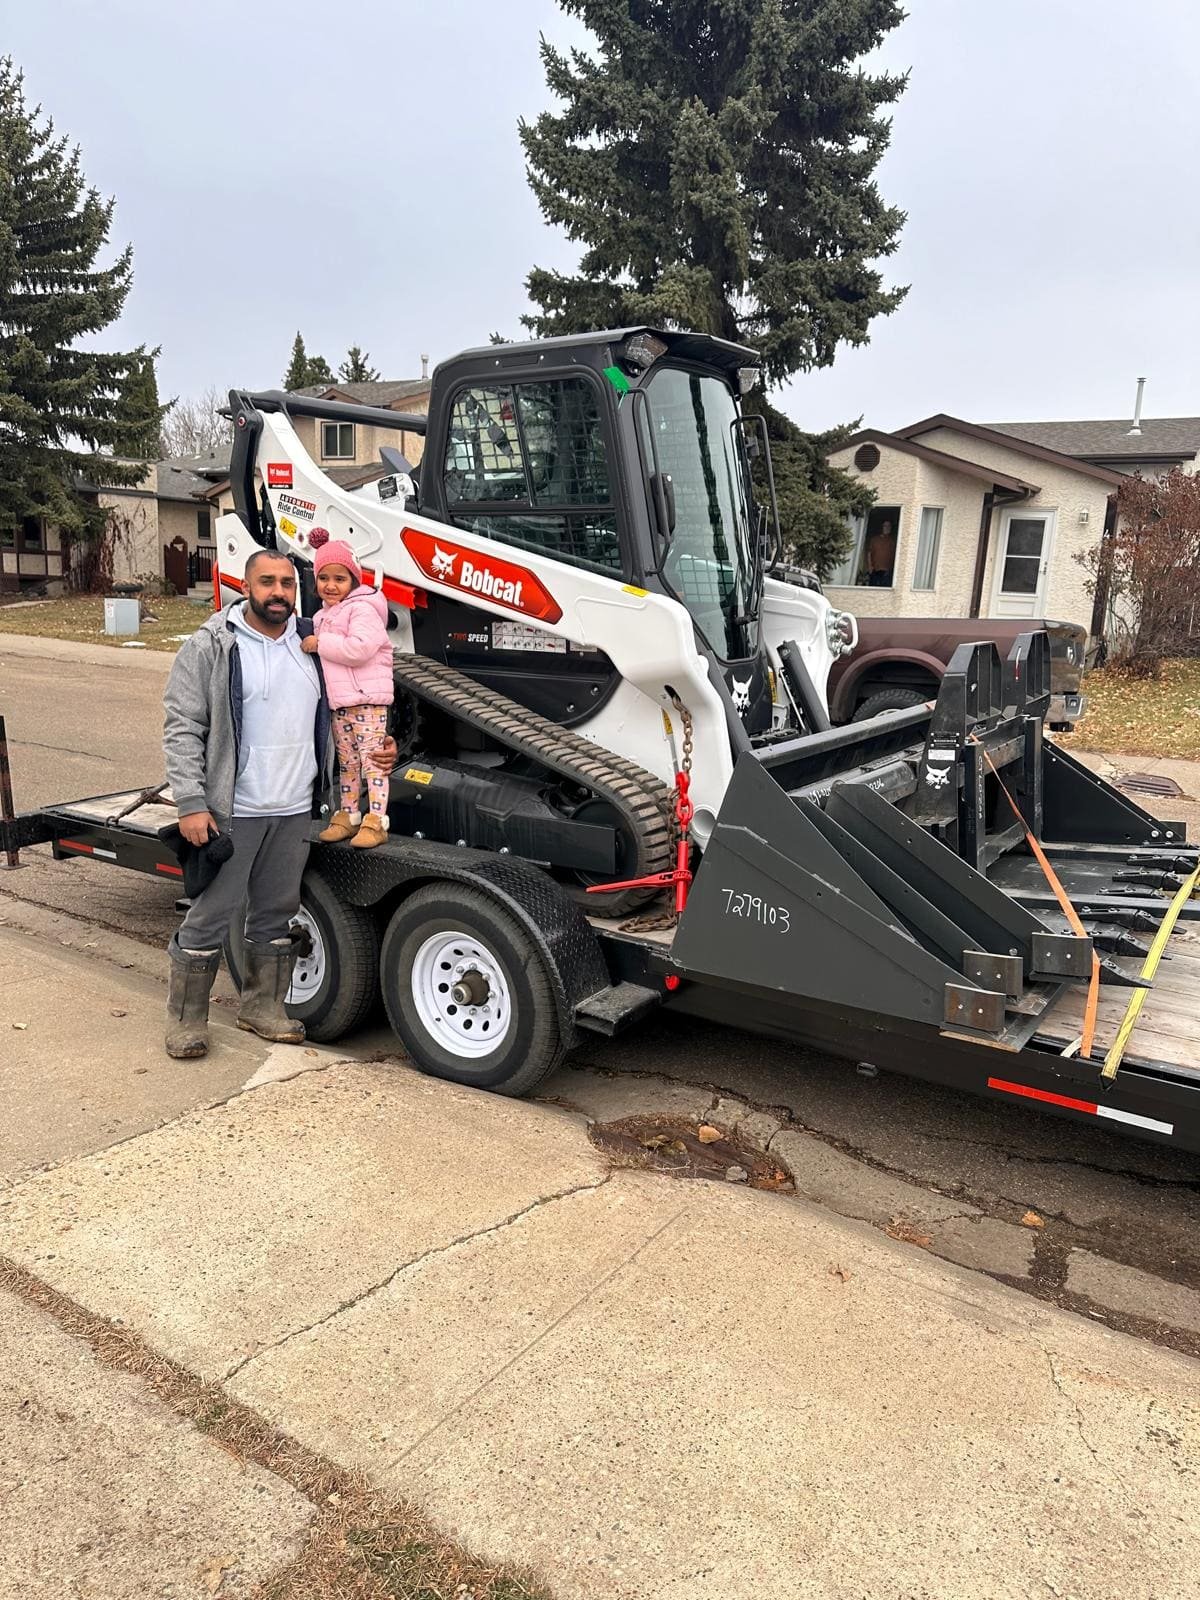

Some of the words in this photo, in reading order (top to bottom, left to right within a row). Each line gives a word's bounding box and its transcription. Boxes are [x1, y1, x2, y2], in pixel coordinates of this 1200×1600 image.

[277, 501, 292, 513] Ride
[292, 506, 315, 520] Control
[281, 494, 316, 511] AUTOMATIC
[460, 560, 523, 606] Bobcat
[468, 633, 488, 643] SPEED
[721, 888, 790, 933] 7279103
